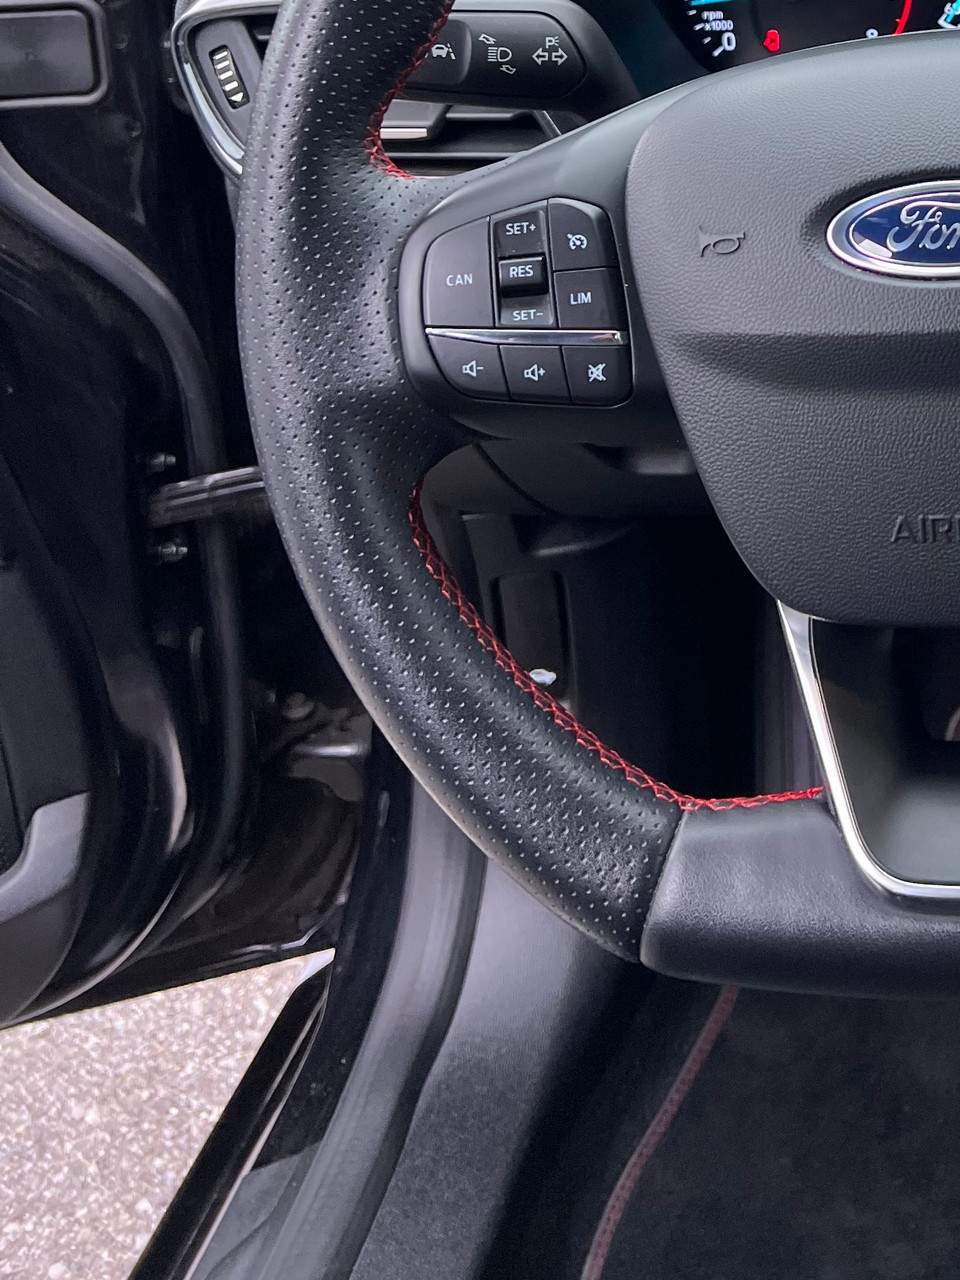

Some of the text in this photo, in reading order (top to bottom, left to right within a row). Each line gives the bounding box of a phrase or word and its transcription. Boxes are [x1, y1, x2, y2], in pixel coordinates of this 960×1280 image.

[701, 10, 724, 21] rpm
[704, 19, 734, 31] x1000
[721, 31, 737, 52] 0
[505, 222, 536, 236] SET+
[509, 265, 534, 278] RES
[446, 273, 473, 287] CAN
[570, 292, 592, 305] LIM
